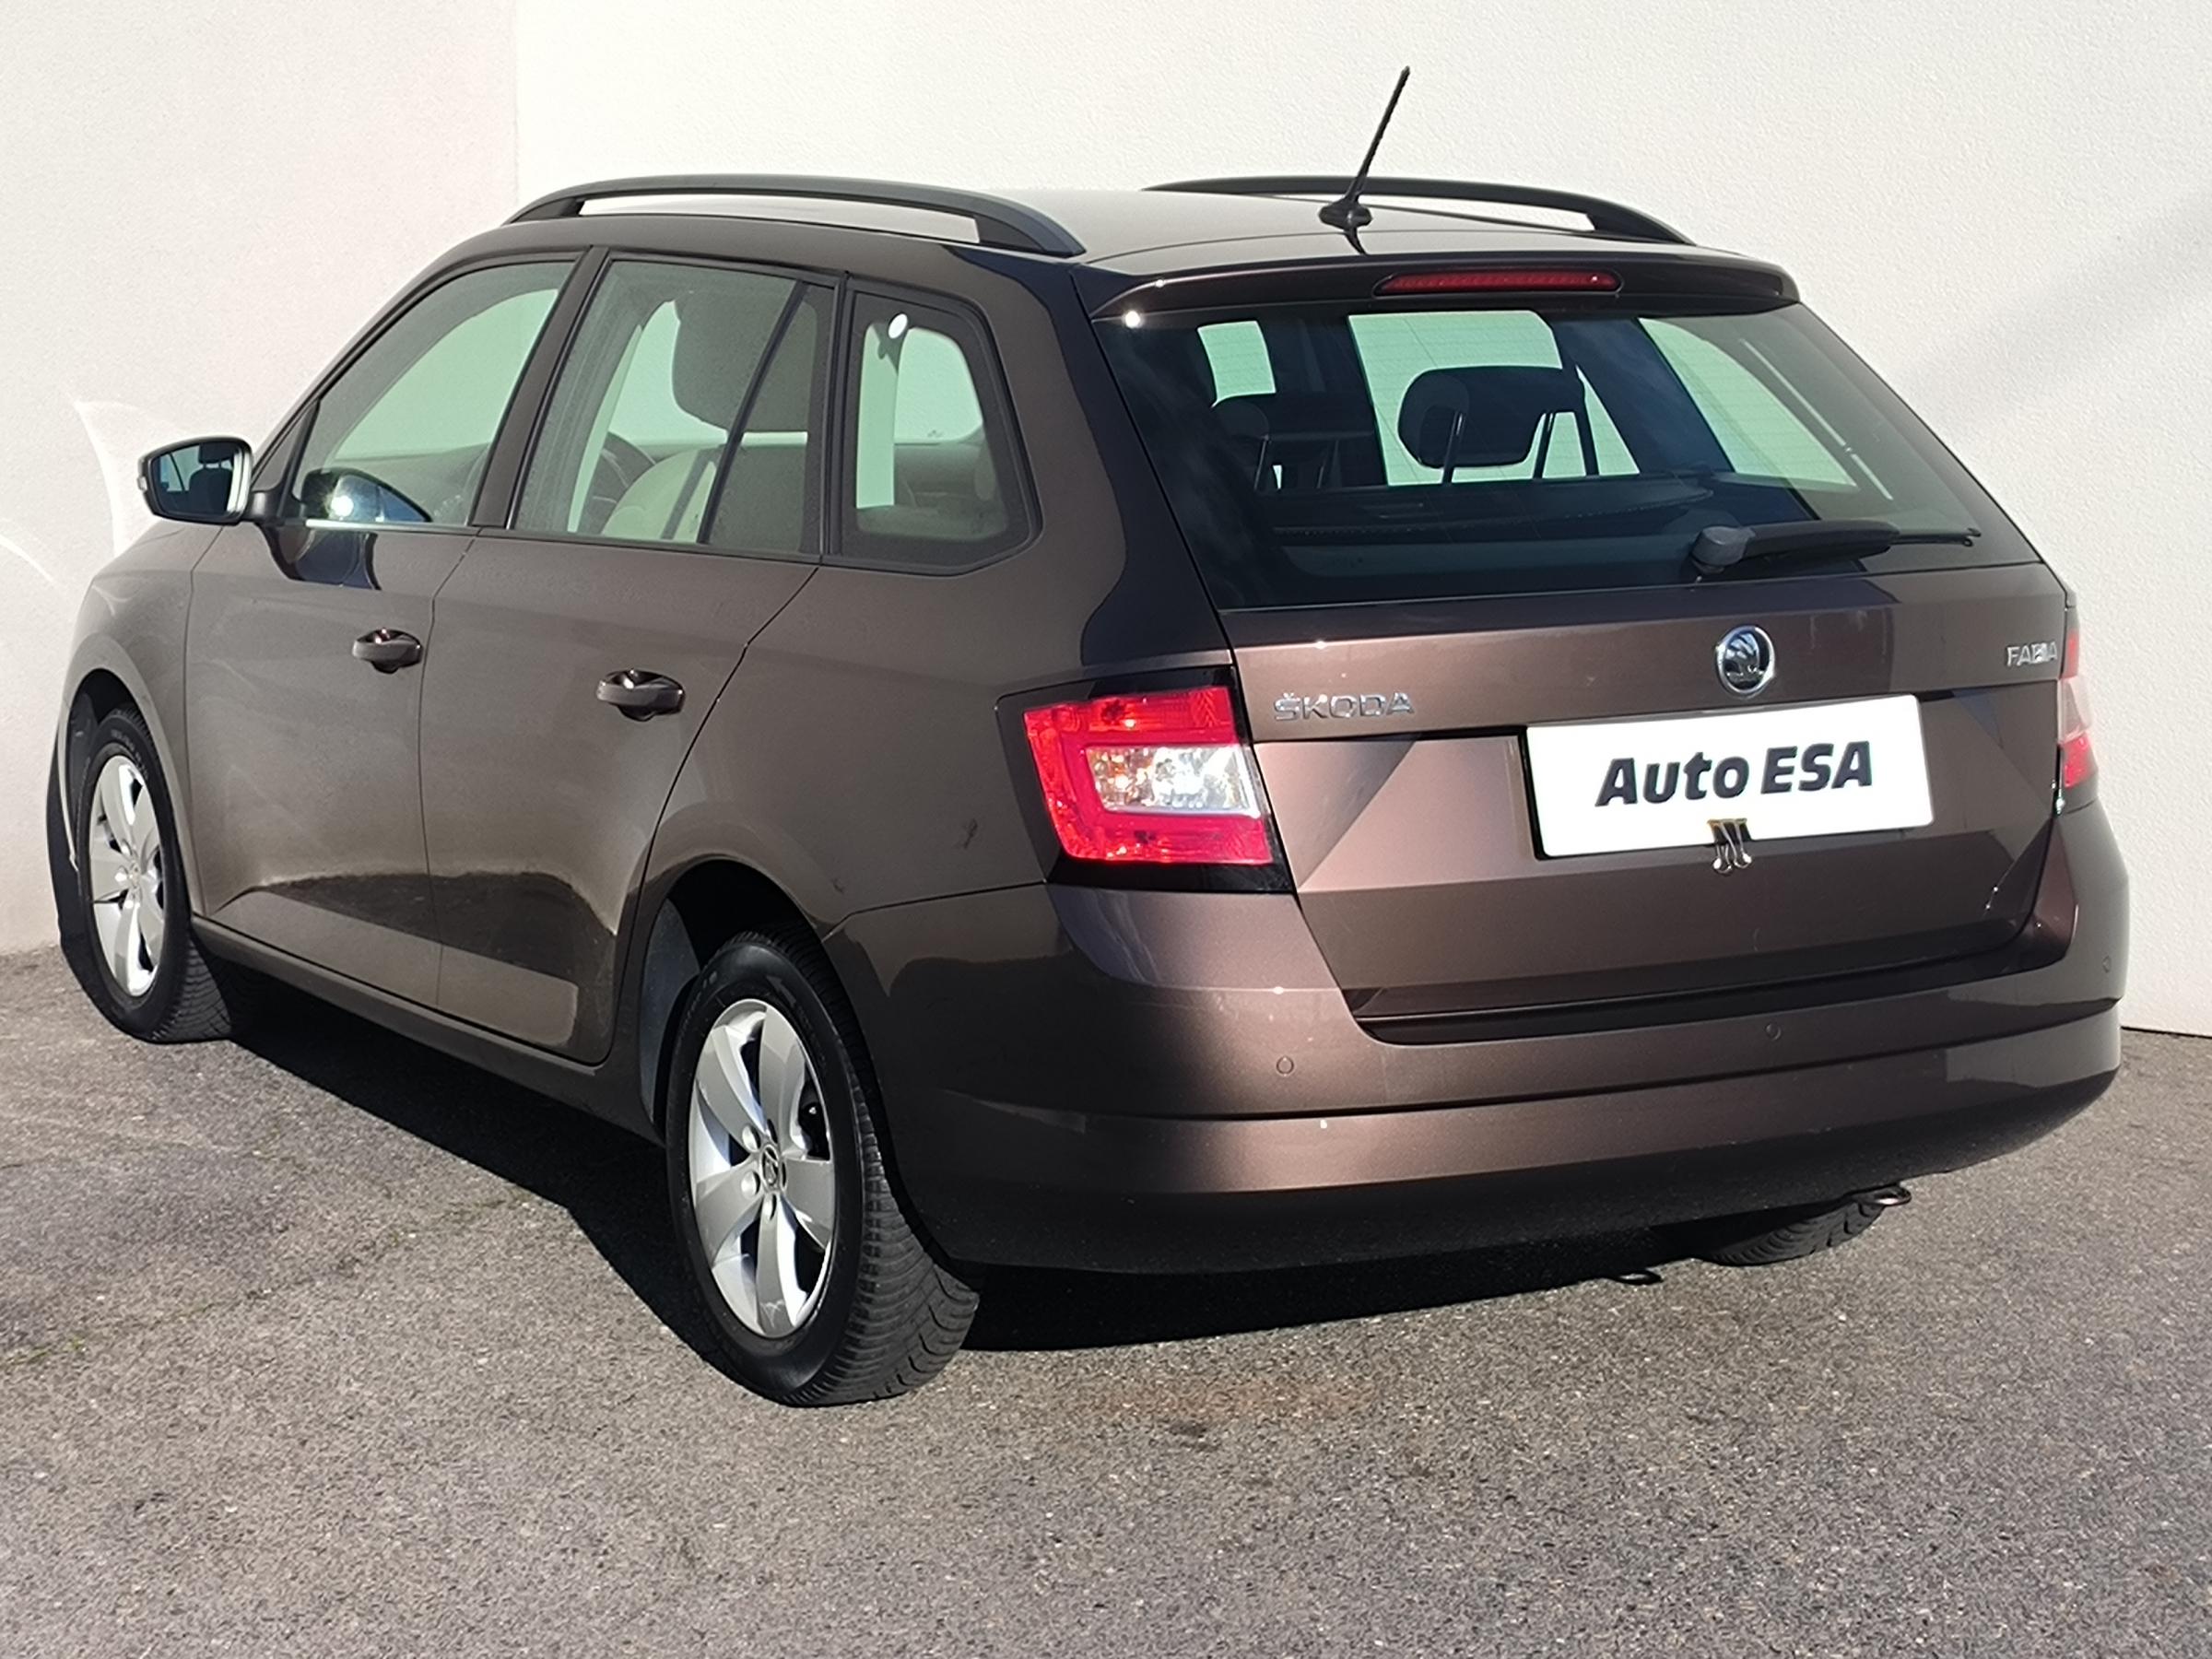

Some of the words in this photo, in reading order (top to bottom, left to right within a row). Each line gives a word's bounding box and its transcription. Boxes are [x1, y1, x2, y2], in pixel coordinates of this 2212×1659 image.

[1274, 691, 1414, 721] ŠKODA
[1594, 751, 1750, 807] Auto
[1760, 740, 1873, 794] ESA
